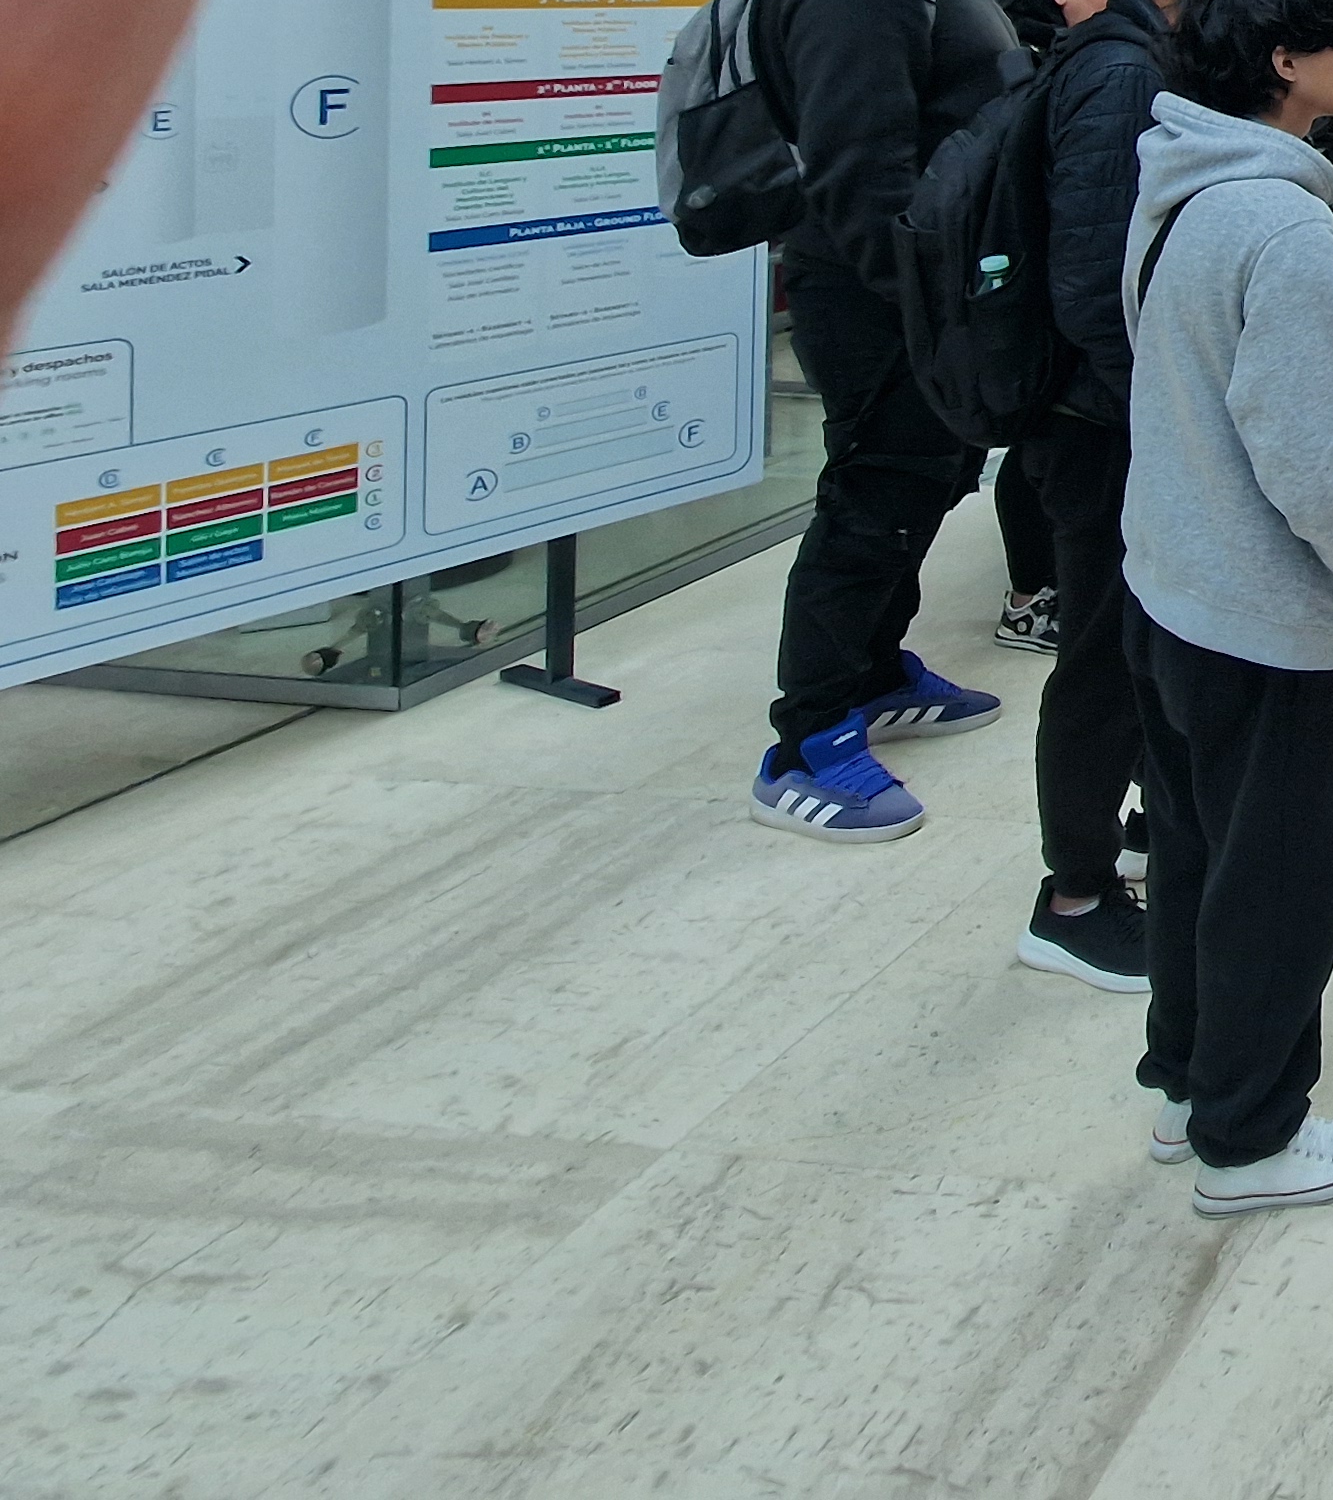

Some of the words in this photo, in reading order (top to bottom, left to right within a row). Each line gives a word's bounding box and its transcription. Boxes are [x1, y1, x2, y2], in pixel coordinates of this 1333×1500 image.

[553, 83, 597, 93] PLANTA
[319, 88, 350, 126] F
[153, 110, 172, 132] E
[552, 142, 596, 153] PLANTA
[508, 224, 555, 238] PLANTA
[556, 221, 586, 232] BAJA
[594, 215, 642, 227] GROUND
[643, 212, 665, 222] FLO
[150, 263, 167, 274] DE
[170, 258, 213, 271] ACTOS
[80, 280, 115, 293] SALA
[195, 267, 231, 280] PIDAL
[22, 352, 114, 372] despachos
[512, 436, 525, 451] B
[687, 425, 701, 442] F
[471, 476, 488, 496] A
